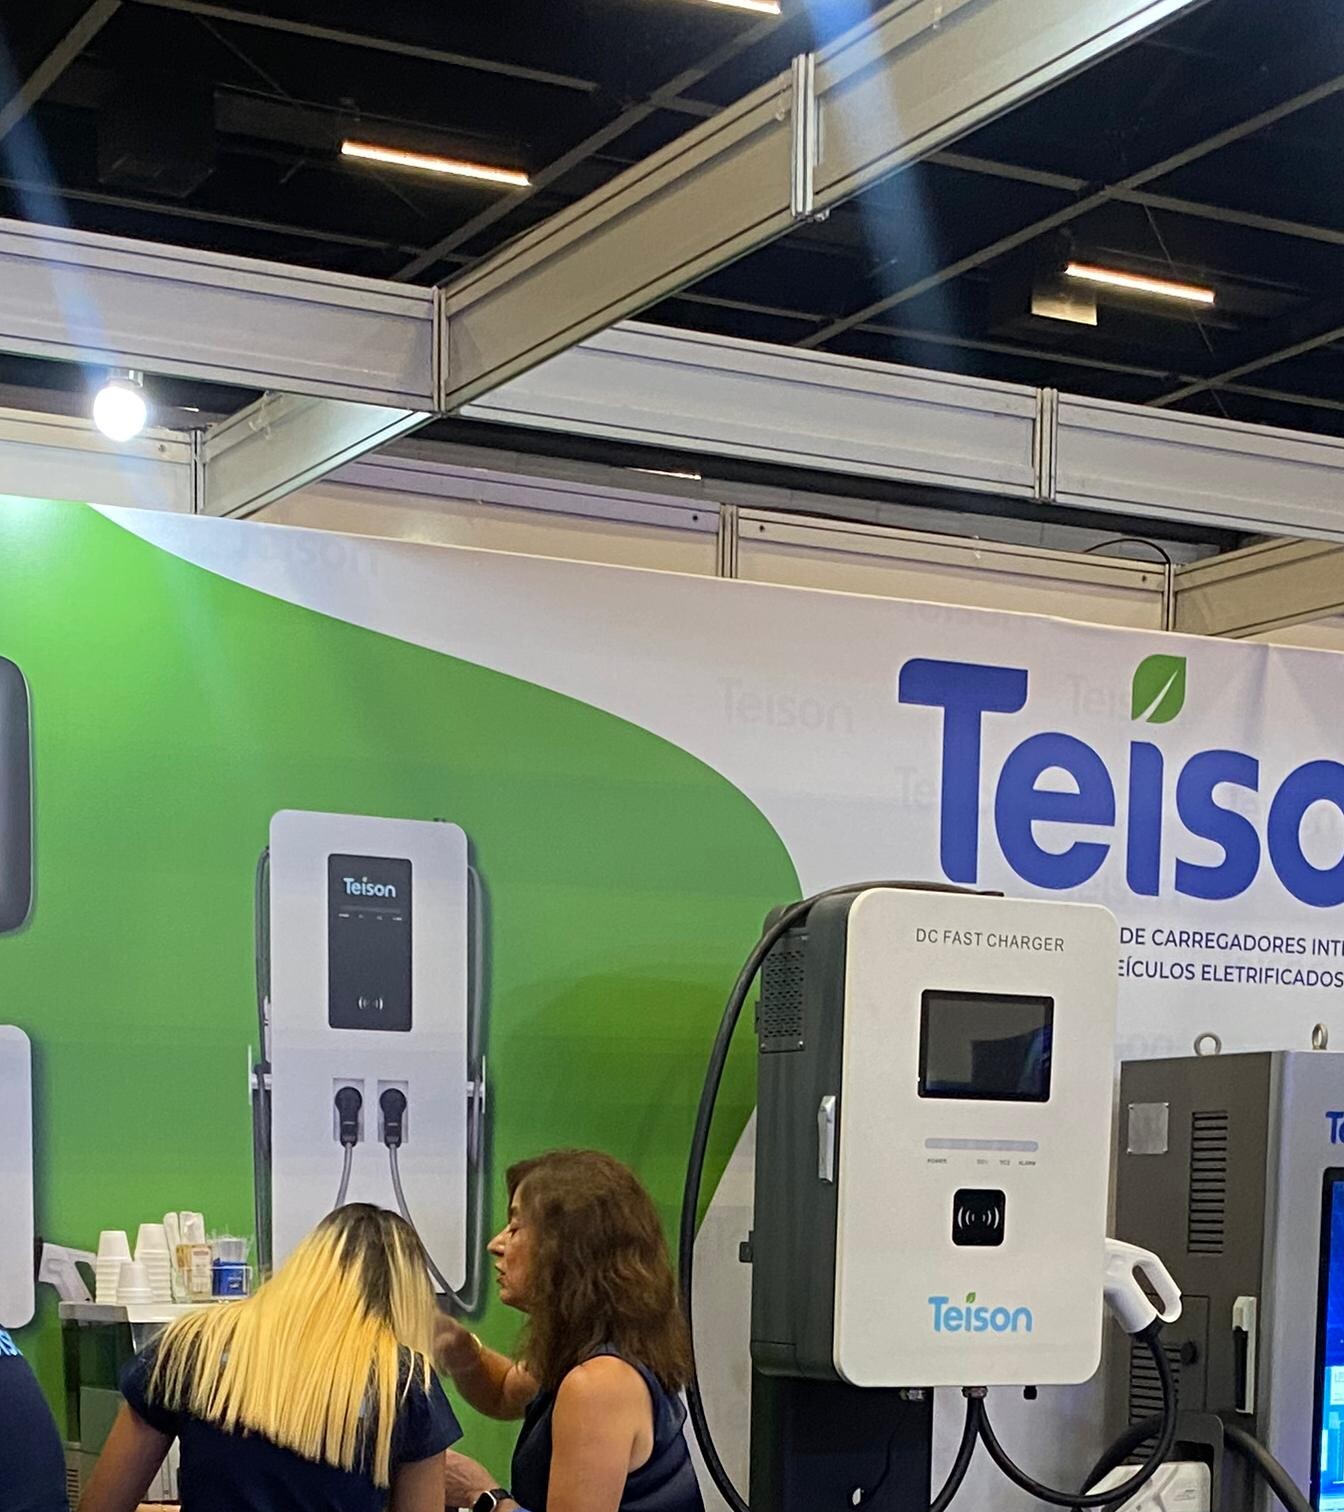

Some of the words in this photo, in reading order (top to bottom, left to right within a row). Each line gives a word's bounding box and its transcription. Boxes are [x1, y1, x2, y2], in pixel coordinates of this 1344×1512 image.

[343, 876, 396, 898] Teison
[916, 928, 938, 943] DC
[943, 930, 983, 946] FAST
[987, 933, 1065, 952] CHARGER
[1119, 927, 1146, 946] DE
[1151, 929, 1307, 955] CARREGADORES
[928, 1291, 1033, 1332] Teison
